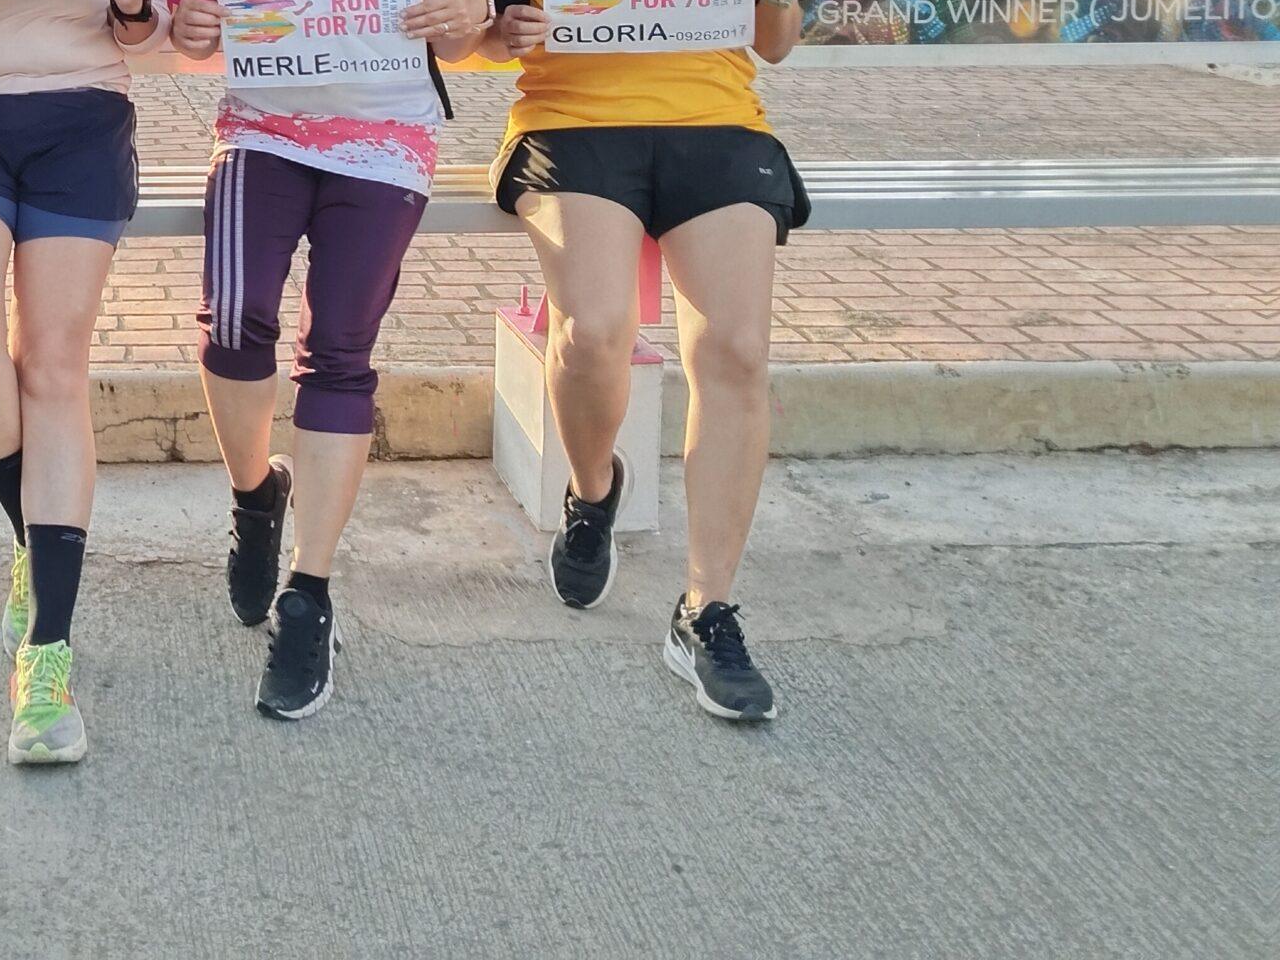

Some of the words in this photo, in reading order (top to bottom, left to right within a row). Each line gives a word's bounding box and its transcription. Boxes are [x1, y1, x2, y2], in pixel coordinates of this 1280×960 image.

[819, 0, 937, 25] GRAND
[303, 15, 348, 38] FOR
[354, 14, 382, 35] 70
[552, 22, 747, 43] GLORIA-09262017
[232, 53, 421, 79] MERLE-01102010
